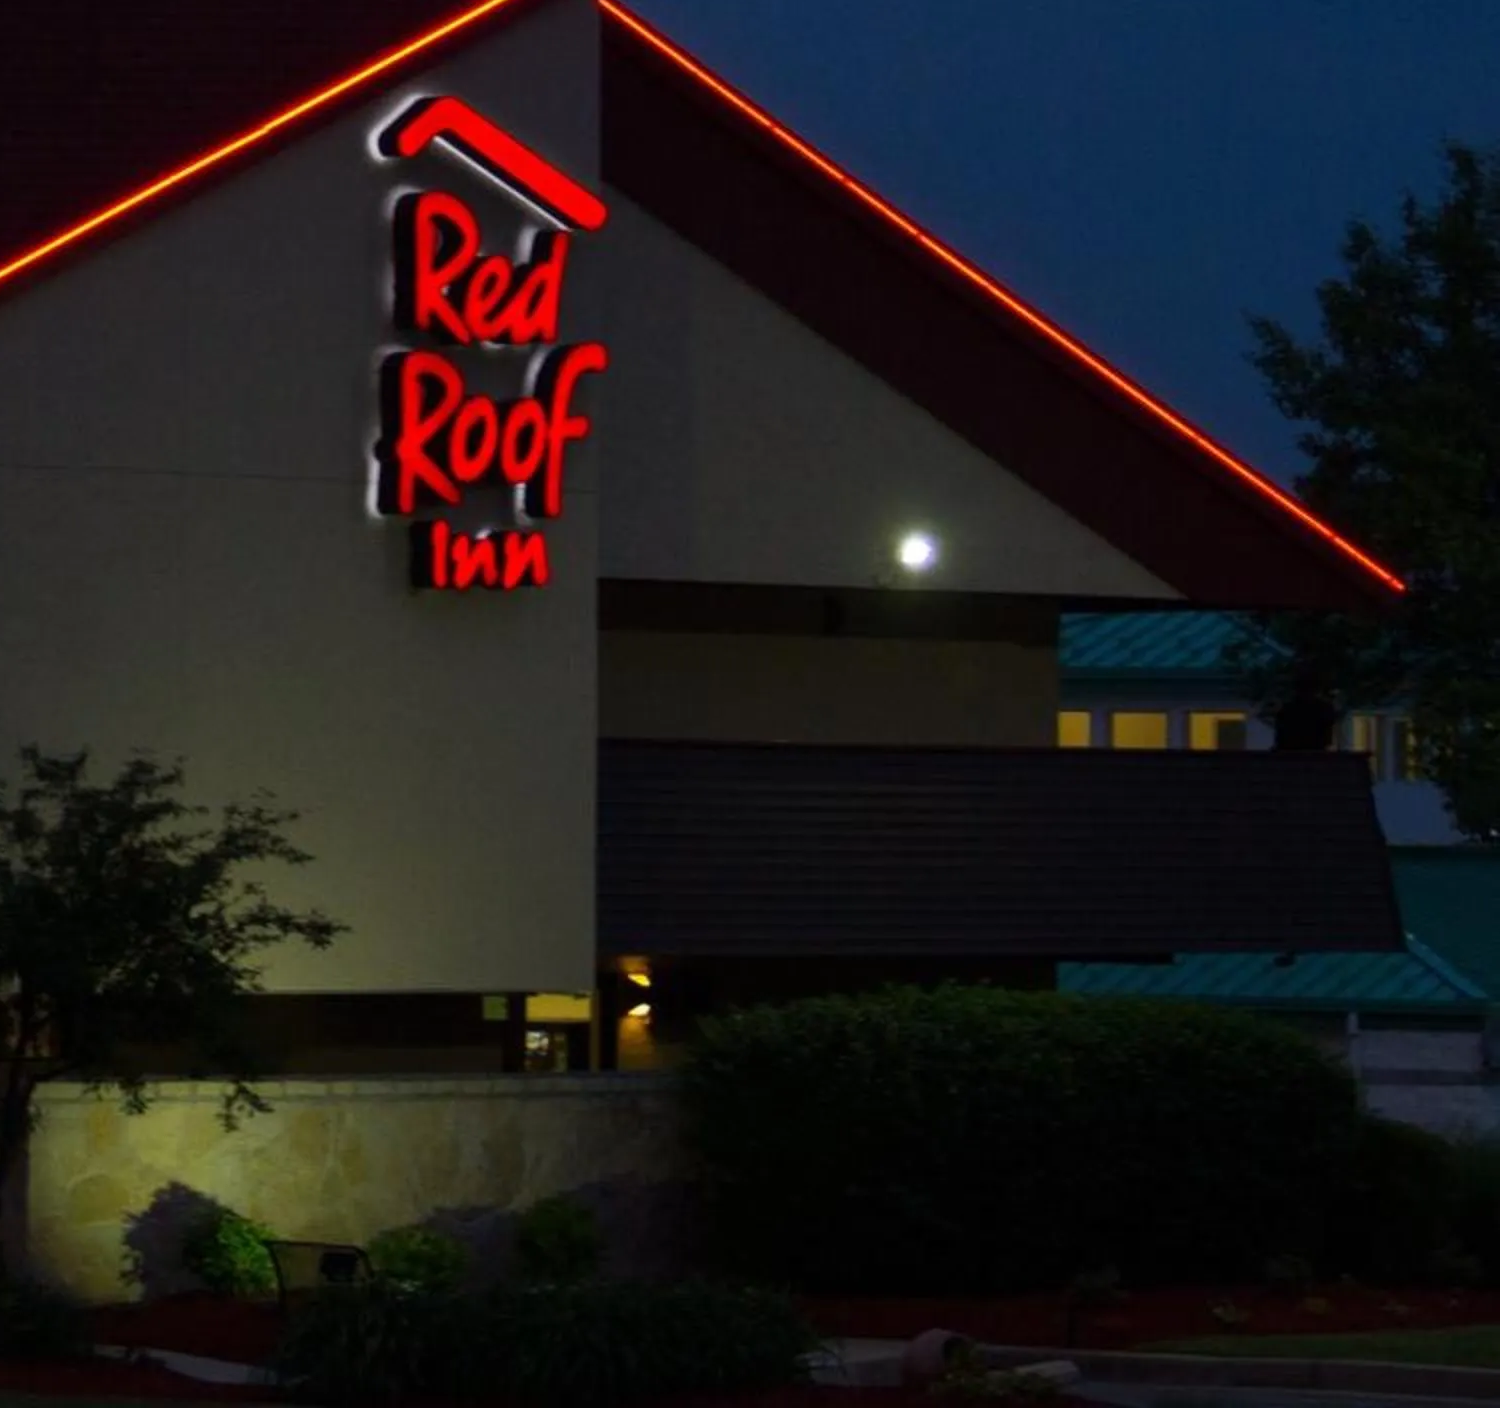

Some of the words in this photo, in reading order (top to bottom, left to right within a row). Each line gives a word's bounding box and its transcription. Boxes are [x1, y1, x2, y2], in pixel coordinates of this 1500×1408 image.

[415, 192, 568, 344] Red
[396, 344, 607, 516] Roof
[431, 520, 549, 589] Inn
